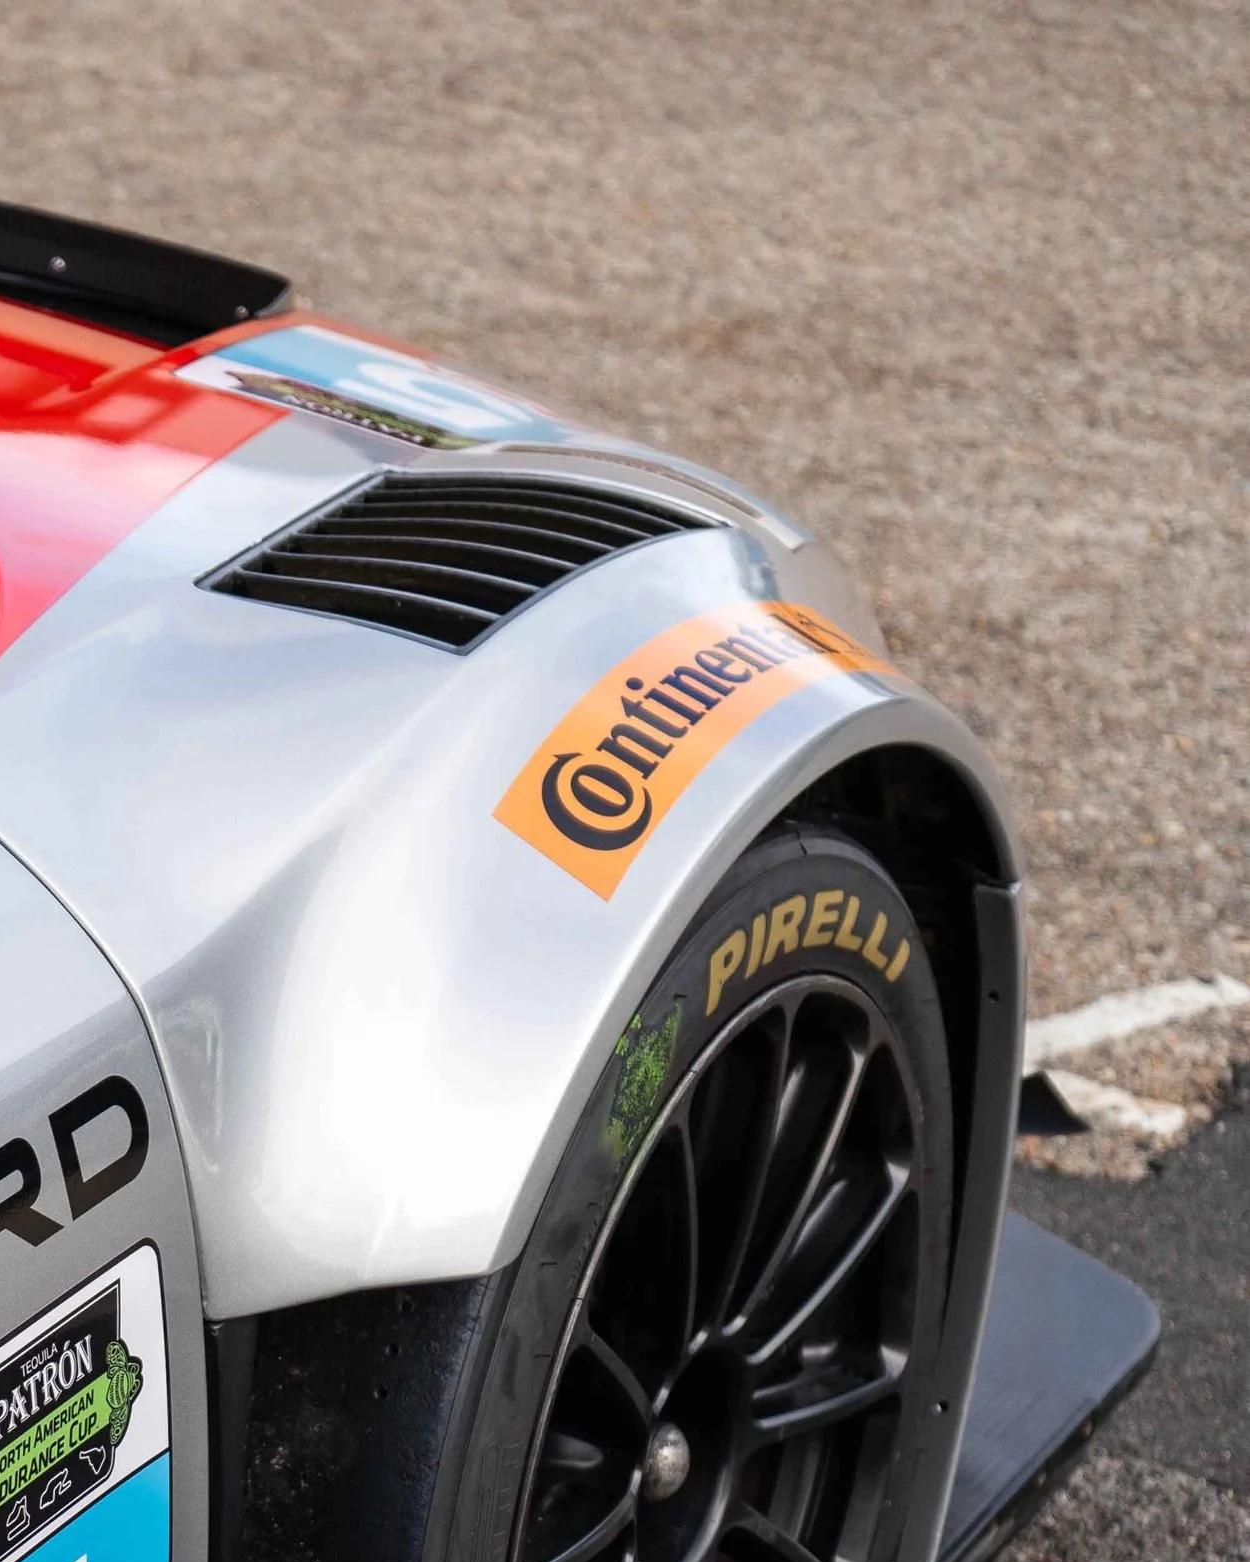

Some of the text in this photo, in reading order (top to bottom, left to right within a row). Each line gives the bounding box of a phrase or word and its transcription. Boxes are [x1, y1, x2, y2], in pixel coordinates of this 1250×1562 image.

[541, 611, 838, 852] Continental
[706, 890, 910, 1016] PIRELLI
[20, 1342, 58, 1377] TEQUILA
[33, 1389, 94, 1449] AMERICAN
